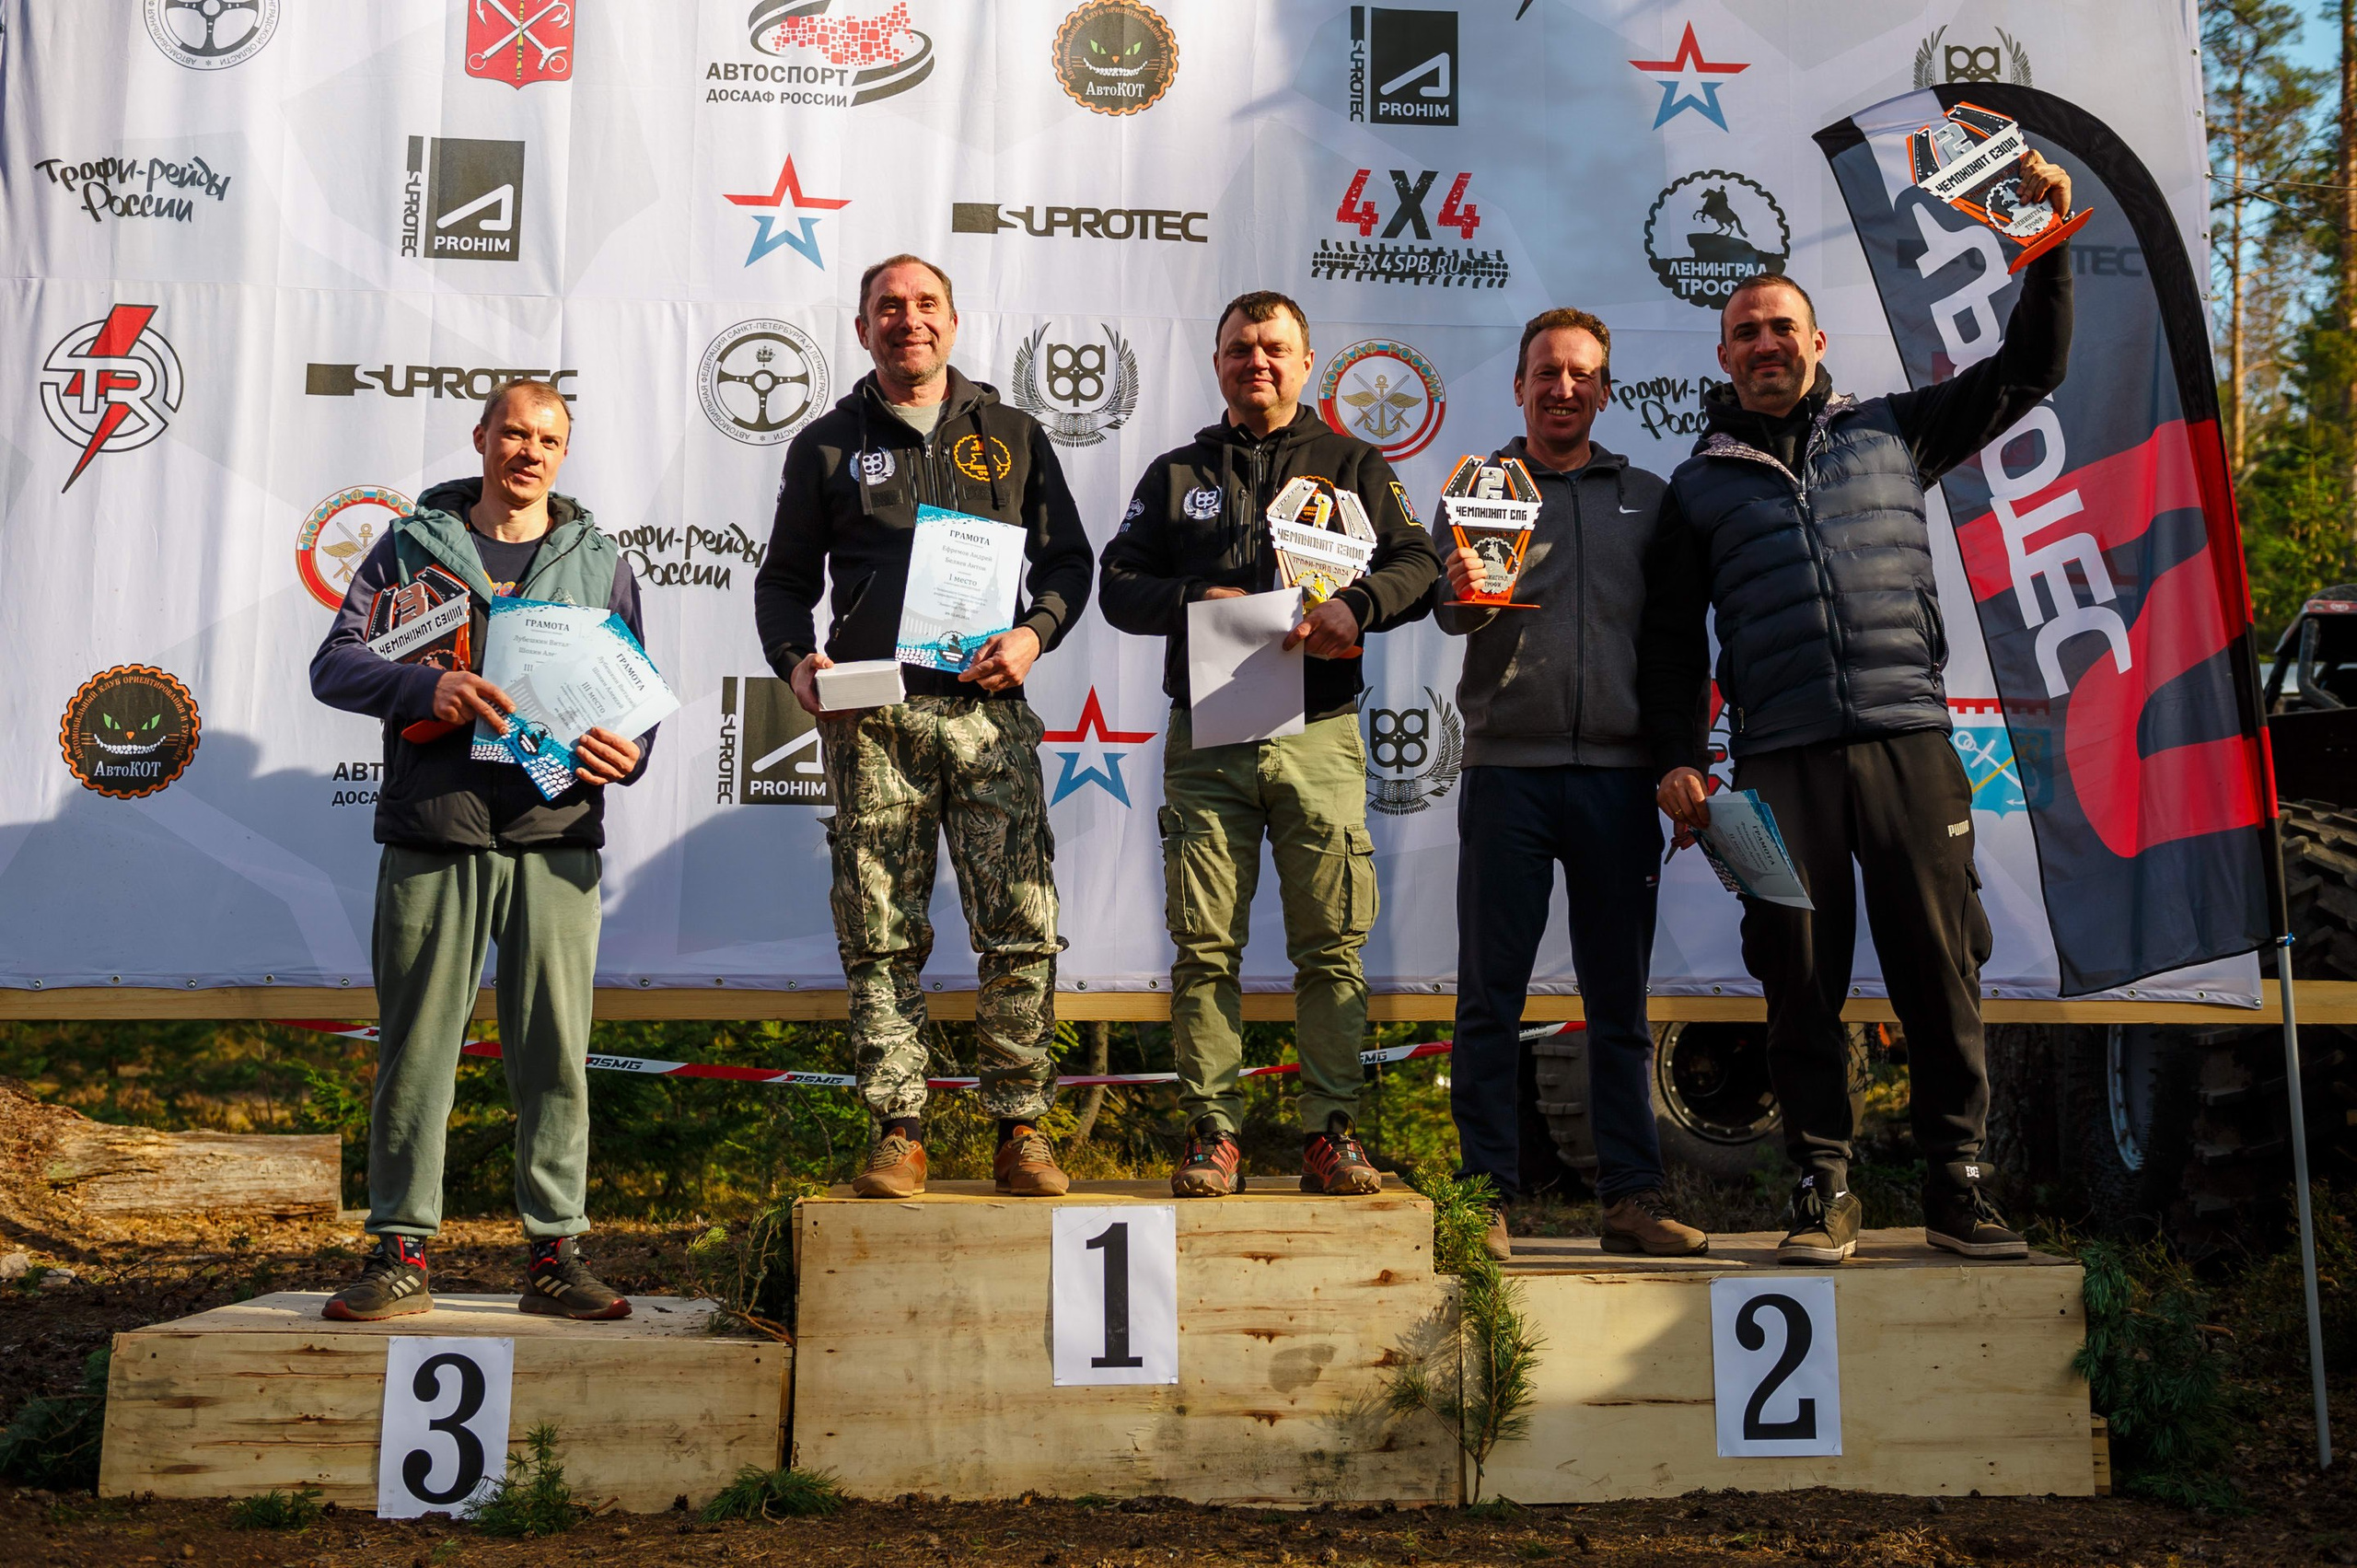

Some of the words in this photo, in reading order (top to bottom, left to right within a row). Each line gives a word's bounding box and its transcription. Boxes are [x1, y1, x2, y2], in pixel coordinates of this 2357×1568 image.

[256, 0, 276, 44] НГРАДСКОЙ
[1085, 9, 1104, 22] КЛУБ
[219, 44, 258, 65] ОБЛАСТИ
[706, 63, 849, 87] АВТОСПОРТ
[1350, 40, 1364, 122] SUPROTEC
[706, 88, 774, 103] ДОСААФ
[780, 92, 847, 108] РОССИИ
[1378, 102, 1450, 118] PROHIM
[1933, 122, 1976, 163] 2
[33, 156, 232, 201] Трофи-рейды
[81, 181, 194, 223] России
[401, 170, 423, 258] SUPROTEC
[1336, 168, 1480, 240] 4X4
[997, 203, 1209, 243] SUPROTEC
[434, 236, 511, 253] PROHIM
[1668, 261, 1767, 277] ЛЕНИНГРАД
[1678, 278, 1740, 296] ТРОФ
[727, 322, 807, 346] САНКТ-ПЕТЕРБУРГА
[701, 336, 728, 383] ФЕДЕРАЦИЯ
[1320, 342, 1378, 397] ДОСААФ
[1387, 343, 1444, 399] РОССИИ
[807, 350, 827, 421] ЛЕНИНГРАДСКОЙ
[702, 385, 751, 440] АВТОМОБИЛЬНАЯ
[1641, 400, 1708, 440] Росс
[1477, 466, 1505, 501] 2
[300, 489, 366, 548] ДОСААФ
[374, 489, 413, 516] РОС
[1314, 493, 1334, 531] 1
[949, 529, 990, 546] ГРАМОТА
[954, 576, 978, 587] место
[397, 581, 429, 626] 3
[525, 619, 570, 632] ГРАМОТА
[616, 653, 645, 691] ГРАМОТА
[72, 691, 99, 760] АВТОМОБИЛЬНЫЙ
[98, 678, 122, 693] КЛУБ
[122, 676, 186, 714] ОРИЕНТИРОВАНИЯ
[588, 691, 606, 714] место
[717, 713, 737, 805] SUPROTEC
[331, 790, 379, 807] ДОСА
[749, 780, 827, 796] PROHIM
[1752, 825, 1775, 865] ГРАМОТА
[1085, 1221, 1144, 1368] 1
[1734, 1293, 1817, 1441] 2
[401, 1352, 487, 1504] 3
